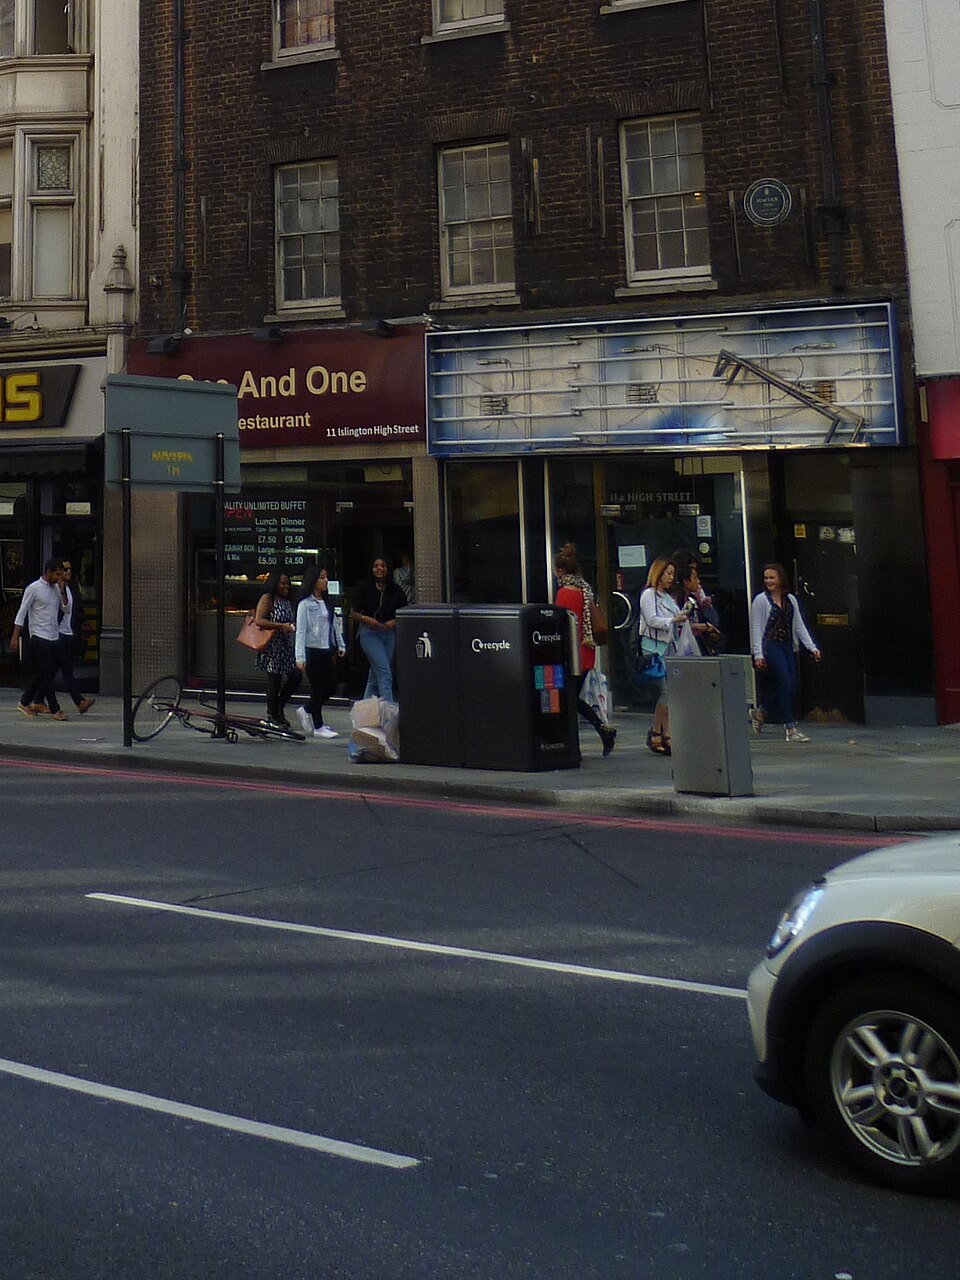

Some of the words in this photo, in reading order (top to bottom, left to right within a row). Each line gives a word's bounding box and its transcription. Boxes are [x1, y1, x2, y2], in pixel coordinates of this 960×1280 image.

[237, 367, 296, 399] And
[305, 365, 367, 396] One
[237, 411, 311, 431] estaurant
[326, 428, 337, 437] 11
[337, 426, 373, 438] Islington
[373, 424, 393, 436] High
[393, 424, 419, 434] Street
[627, 492, 654, 503] HIGH
[655, 492, 691, 502] STREET
[244, 501, 280, 510] UNLIMITED
[280, 501, 306, 510] BUFFET
[255, 517, 278, 526] Lunch
[280, 517, 306, 526] Dinner
[257, 535, 277, 544] £7.50
[284, 535, 304, 544] £9.50
[284, 556, 304, 565] £4.50
[541, 632, 562, 643] recycle
[483, 640, 511, 651] recycle
